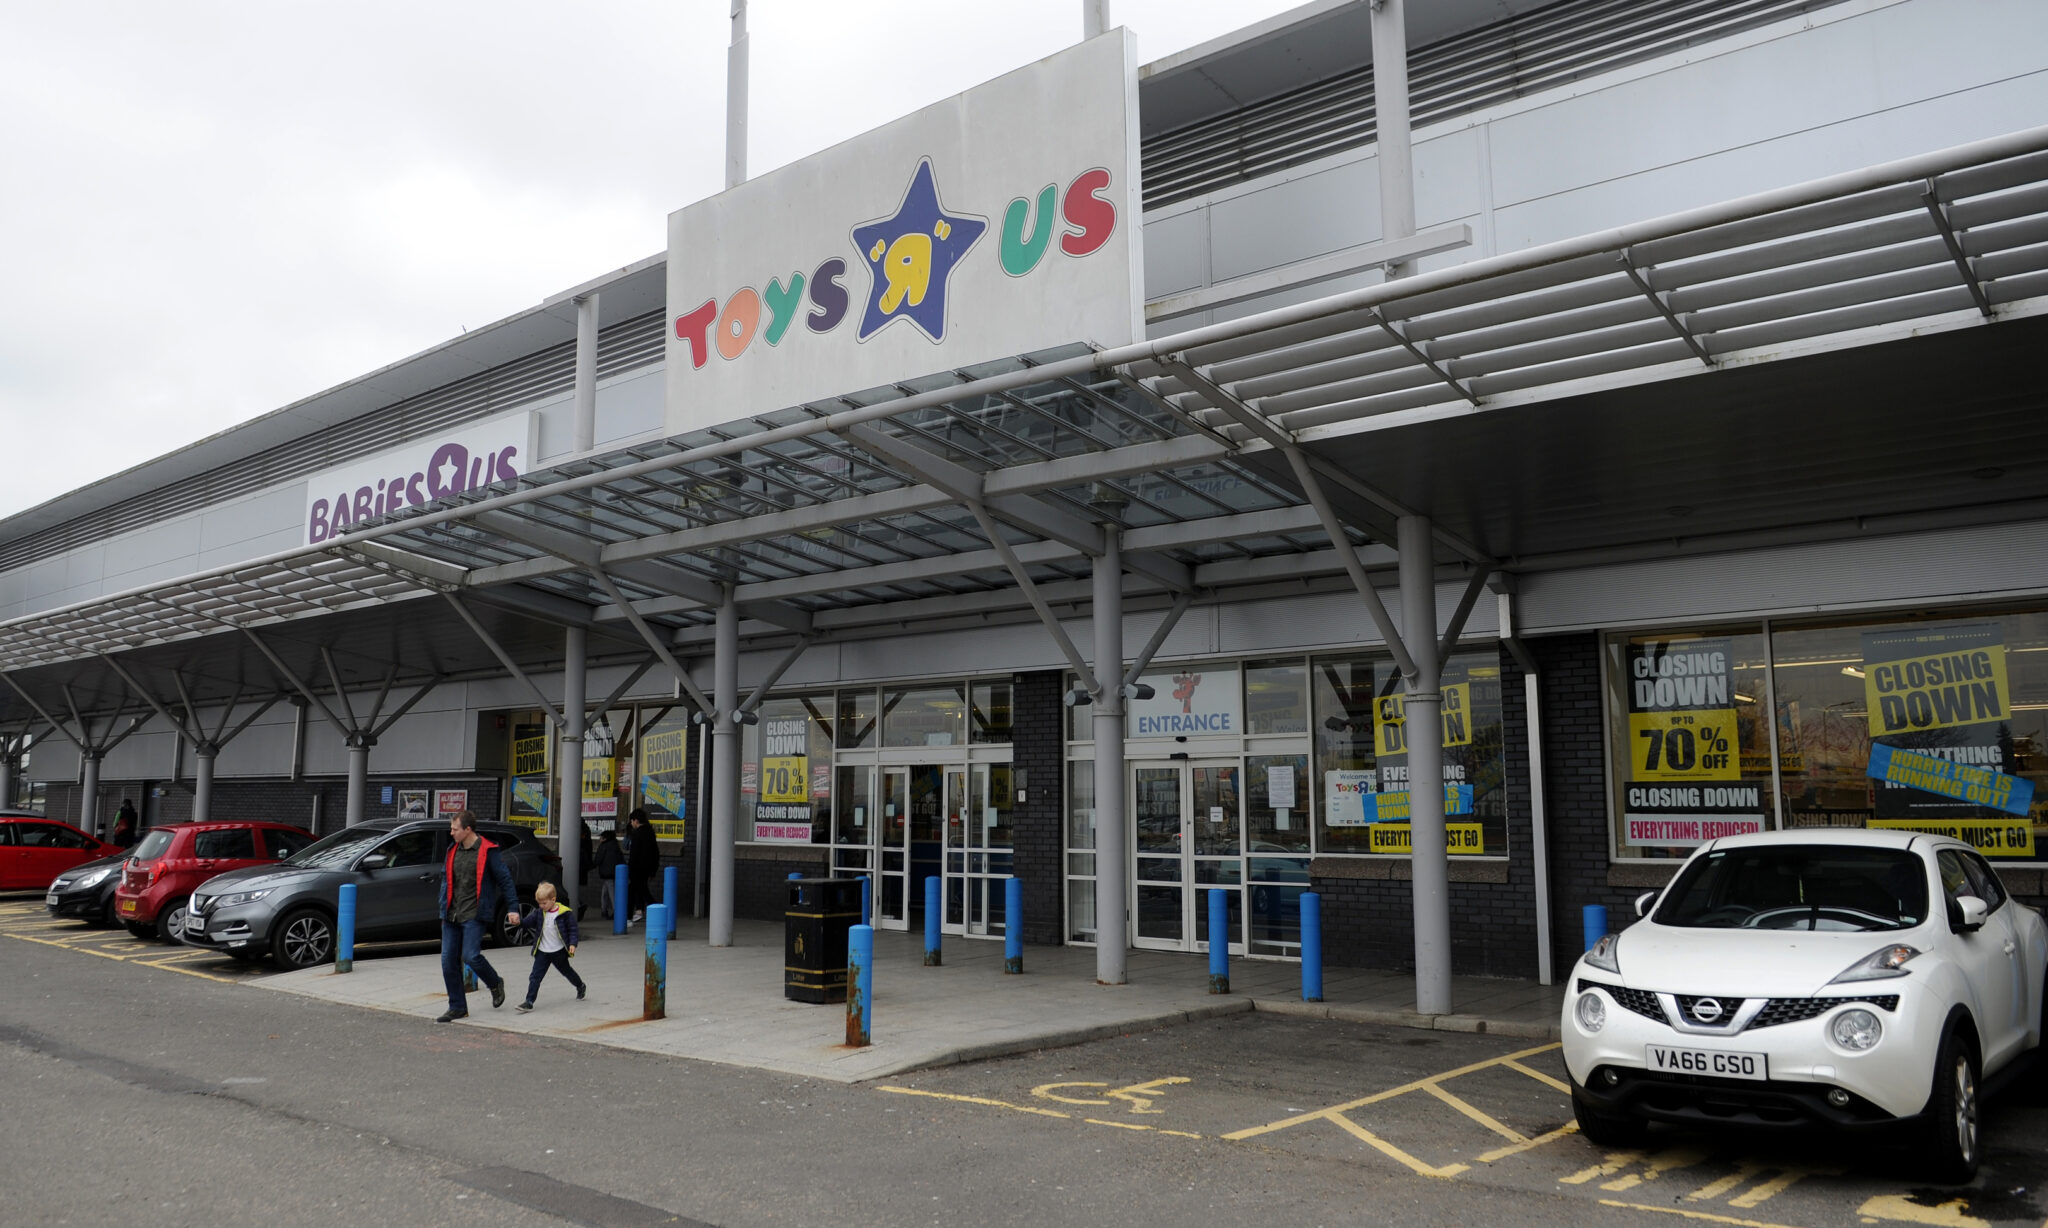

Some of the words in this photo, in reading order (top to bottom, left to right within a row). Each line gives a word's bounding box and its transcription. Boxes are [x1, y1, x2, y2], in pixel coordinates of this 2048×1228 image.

[675, 257, 850, 370] TOYS
[999, 167, 1117, 278] US
[1633, 651, 1726, 679] CLOSING
[1874, 651, 1993, 693] CLOSING
[1634, 675, 1729, 709] DOWN
[1879, 681, 2002, 732] DOWN
[766, 720, 806, 737] CLOSING
[1138, 713, 1231, 733] ENTRANCE
[516, 737, 545, 755] CLOSING
[583, 739, 613, 758] DOWN
[646, 732, 681, 753] CLOSING
[766, 735, 806, 756] DOWN
[516, 752, 545, 774] DOWN
[647, 750, 682, 773] DOWN
[1702, 754, 1729, 769] OFF
[1889, 749, 1950, 777] HURRY!
[1953, 764, 1993, 788] TIME
[1994, 774, 2013, 792] IS
[792, 785, 803, 795] OFF
[1628, 787, 1701, 808] CLOSING
[1703, 787, 1759, 807] DOWN
[1886, 765, 1963, 797] RUNNING
[1966, 784, 2010, 809] OUT!
[757, 806, 787, 819] CLOSING
[788, 807, 811, 820] DOWN
[756, 825, 785, 838] EVERYTHING
[786, 826, 810, 839] REDUCED!
[1464, 830, 1479, 847] GO
[1630, 820, 1700, 840] EVERYTHING
[1961, 827, 2002, 848] MUST
[2006, 826, 2027, 848] GO
[1654, 1049, 1707, 1071] VA66
